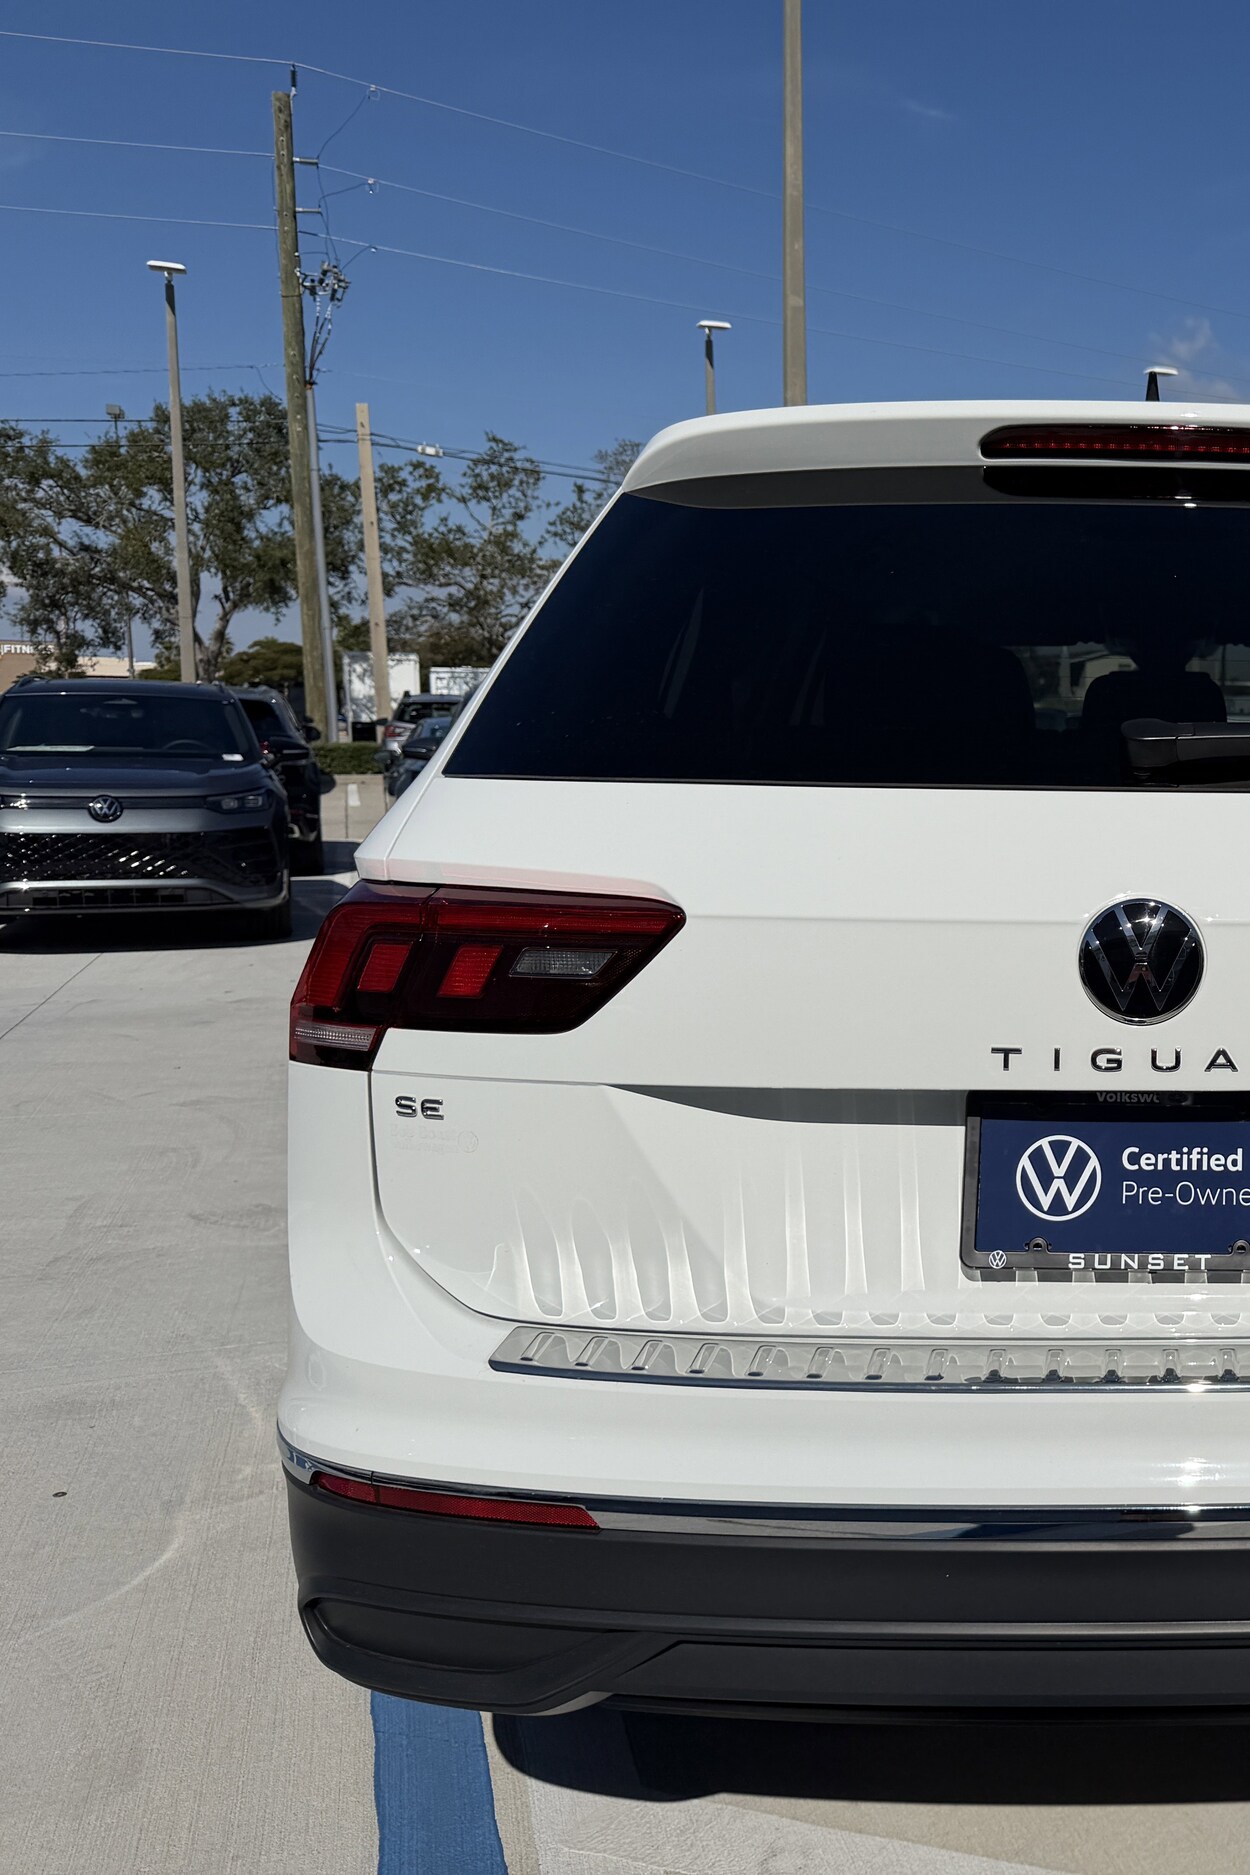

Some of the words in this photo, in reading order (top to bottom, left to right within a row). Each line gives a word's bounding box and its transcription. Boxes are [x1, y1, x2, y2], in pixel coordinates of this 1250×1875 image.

[395, 1096, 444, 1120] SE
[1121, 1147, 1243, 1172] Certified
[1068, 1253, 1212, 1270] SUNSET
